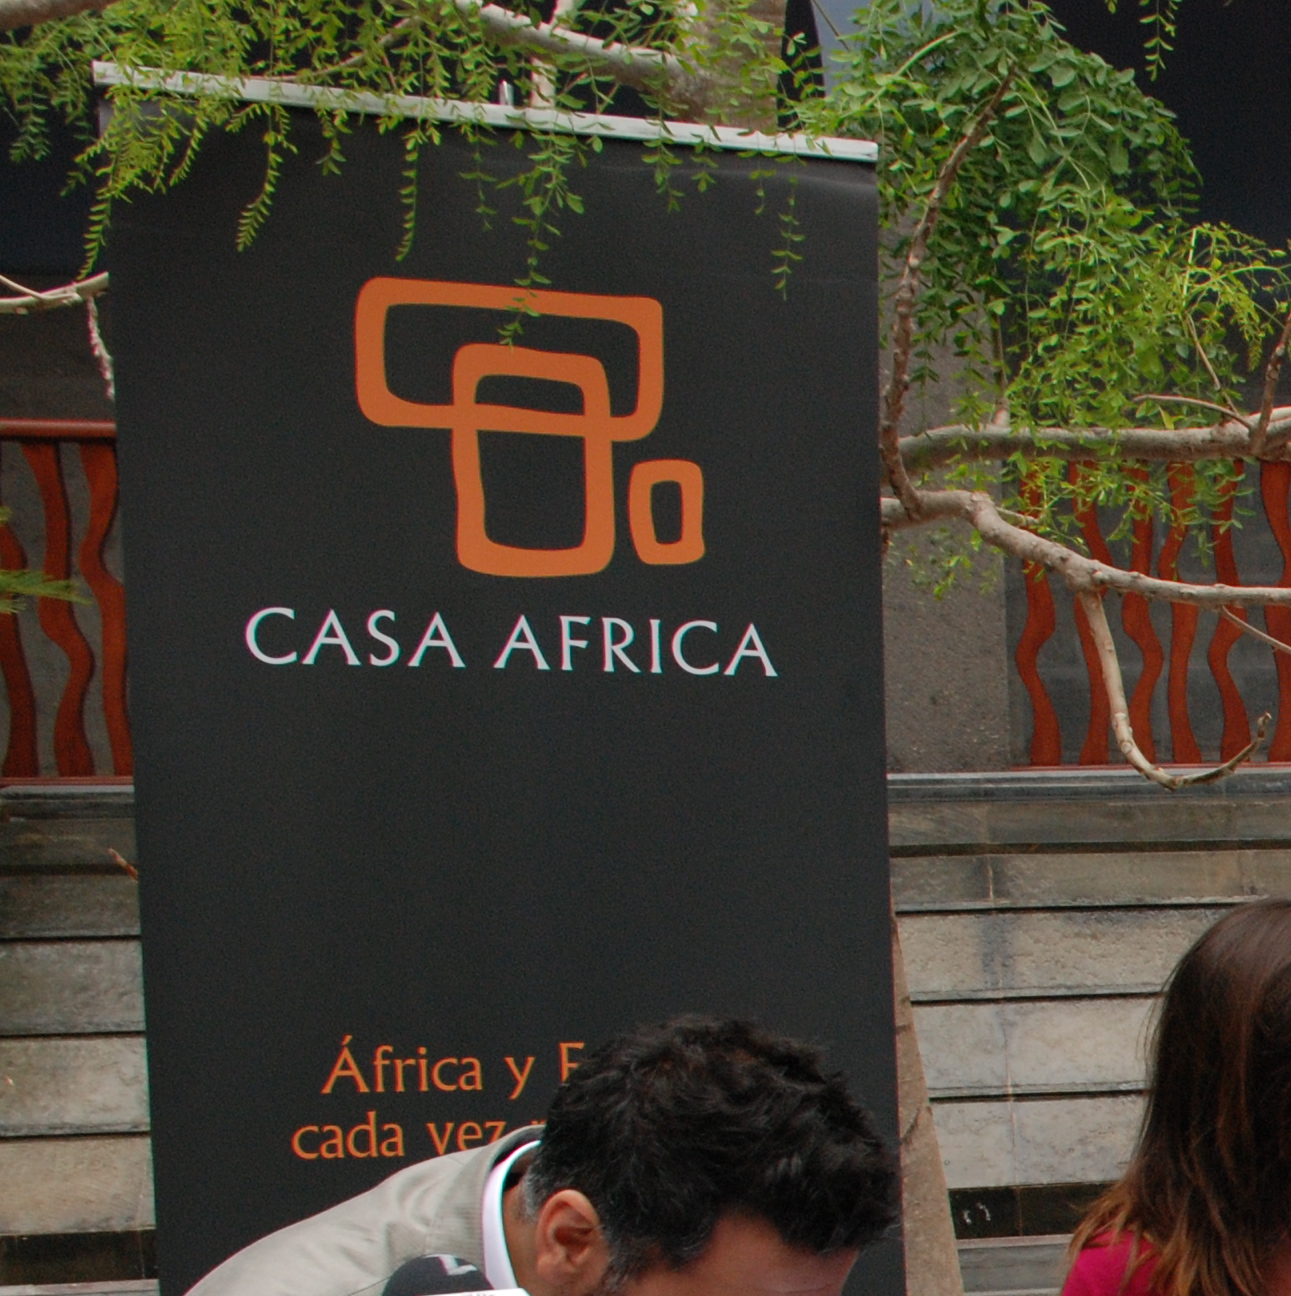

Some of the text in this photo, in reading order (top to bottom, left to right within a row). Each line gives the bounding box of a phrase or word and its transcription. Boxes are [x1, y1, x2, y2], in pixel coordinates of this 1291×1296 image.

[245, 606, 778, 677] CASA AFRICA
[320, 1034, 483, 1094] África
[504, 1056, 536, 1100] y
[291, 1110, 405, 1160] cada
